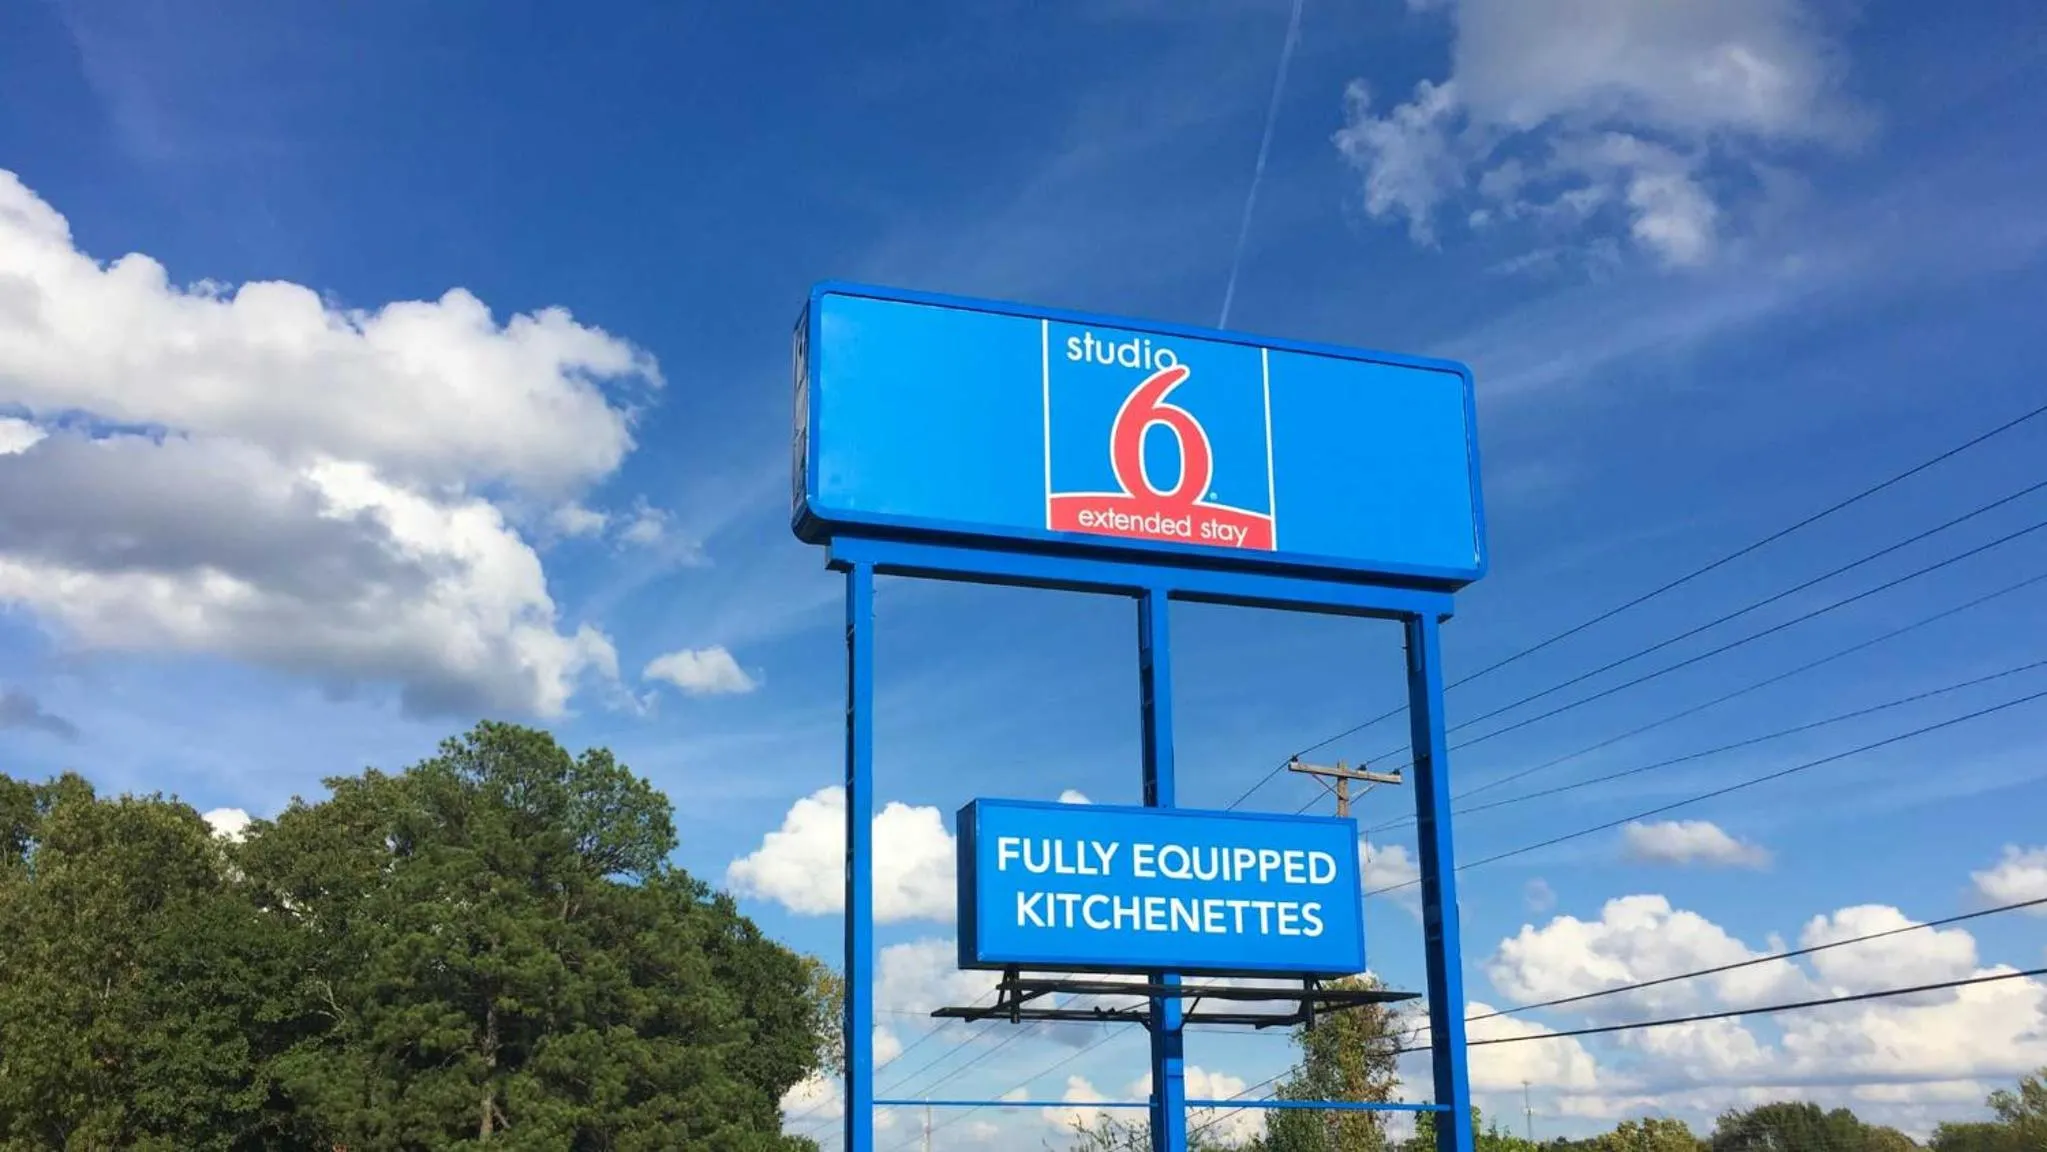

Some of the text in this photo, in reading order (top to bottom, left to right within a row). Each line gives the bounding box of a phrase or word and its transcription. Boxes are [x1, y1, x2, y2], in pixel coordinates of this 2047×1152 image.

[1066, 331, 1178, 371] studio
[1109, 363, 1214, 505] 6
[1077, 507, 1248, 548] extended stay
[997, 836, 1338, 885] FULLY EQUIPPED
[1016, 891, 1324, 938] KITCHENETTES
